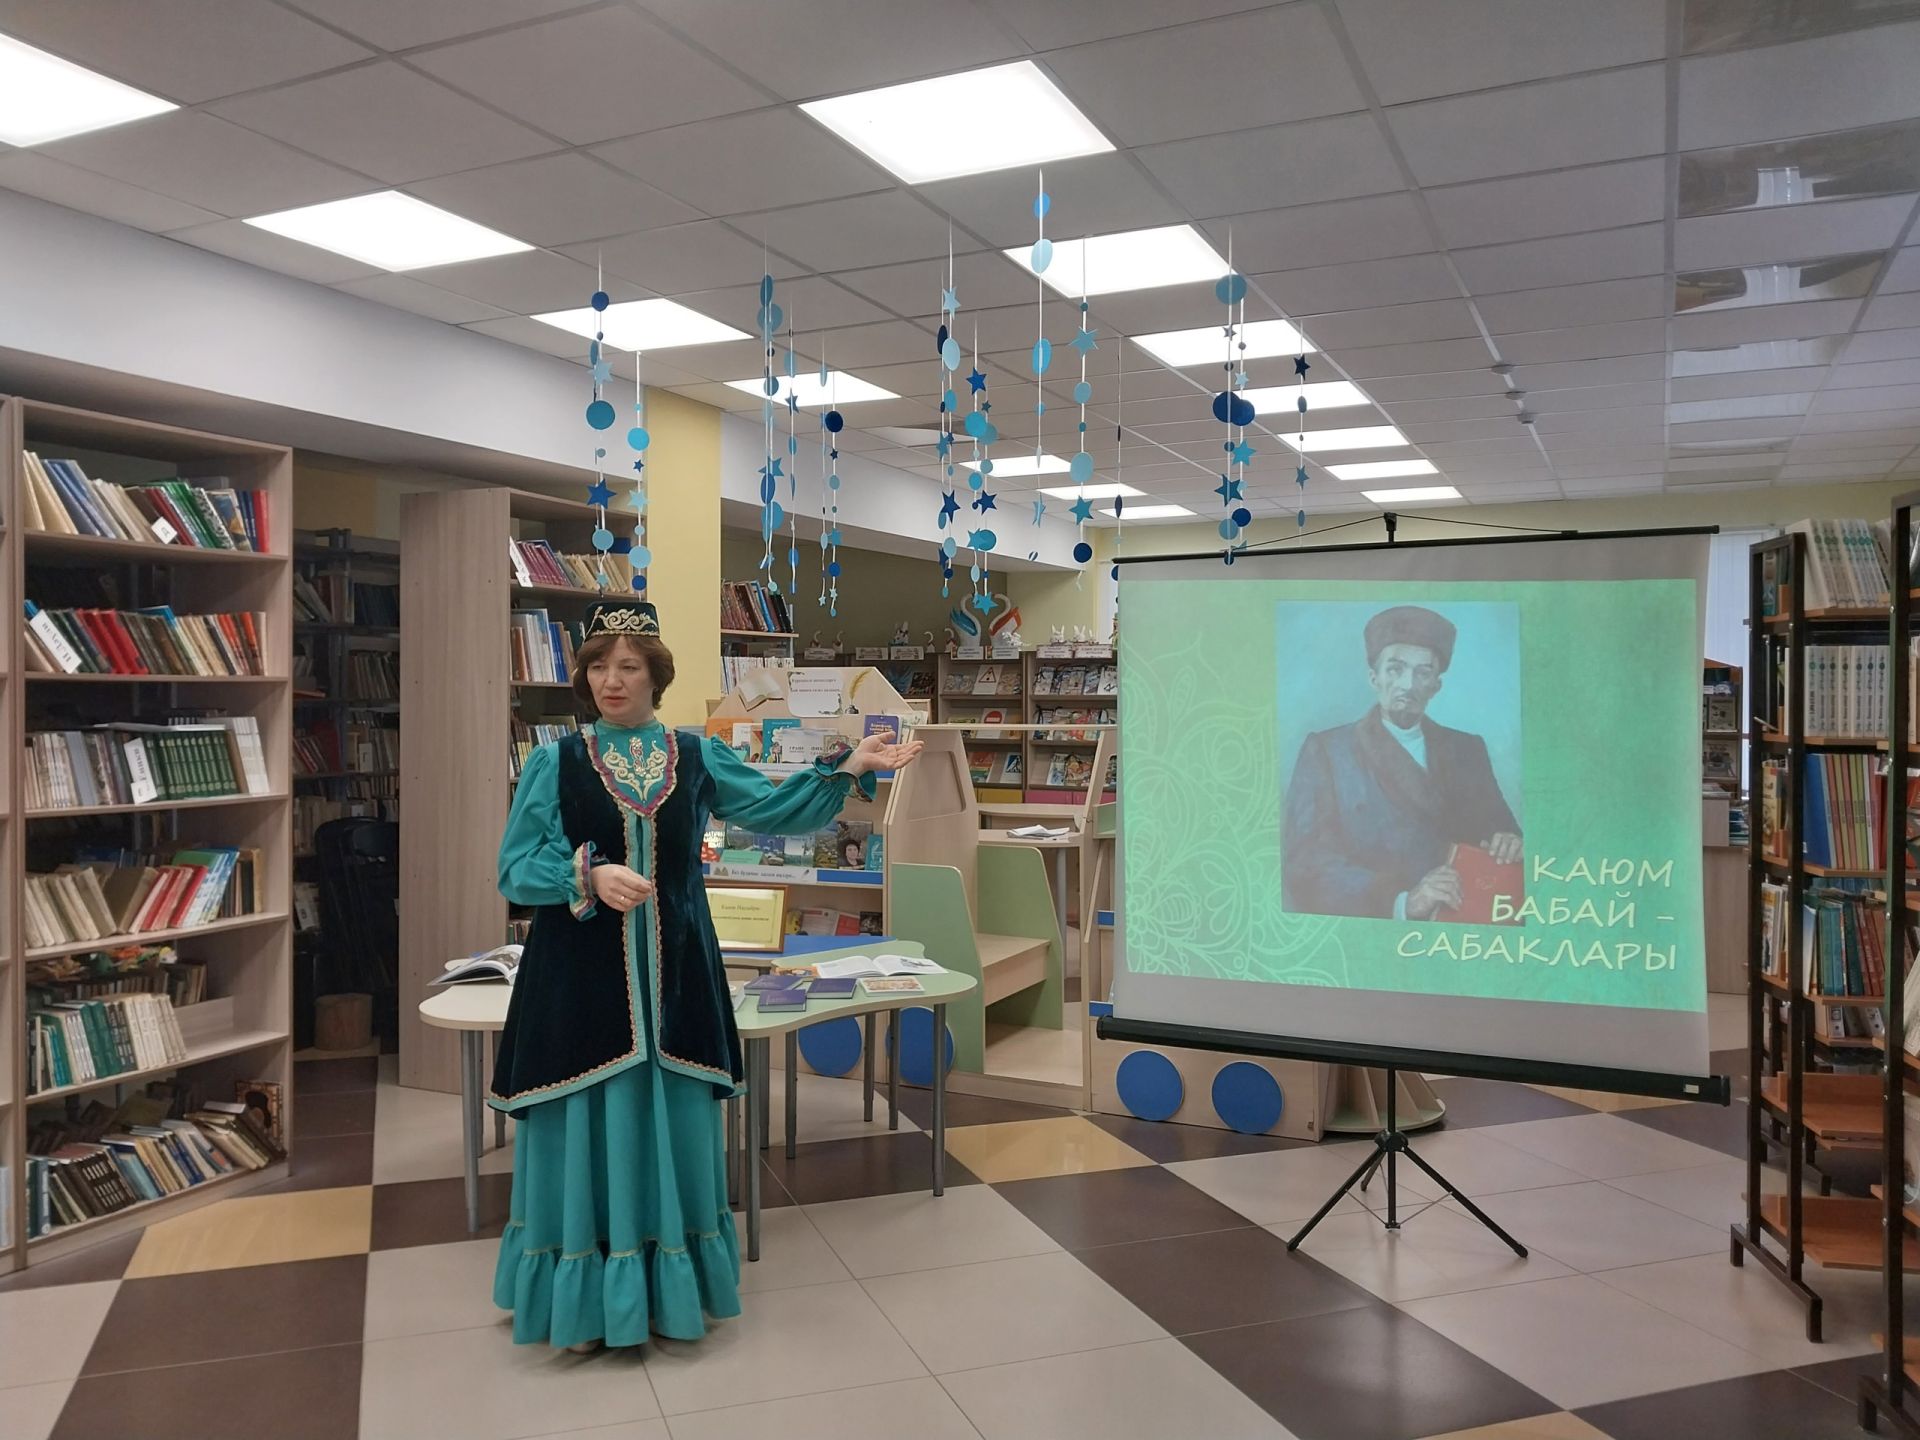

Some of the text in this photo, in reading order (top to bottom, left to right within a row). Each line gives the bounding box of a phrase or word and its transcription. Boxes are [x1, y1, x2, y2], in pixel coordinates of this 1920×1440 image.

[1533, 855, 1674, 888] КАЮМ
[1491, 891, 1636, 928] БАБАЙ
[1397, 931, 1677, 971] САБАКЛАРЫ
